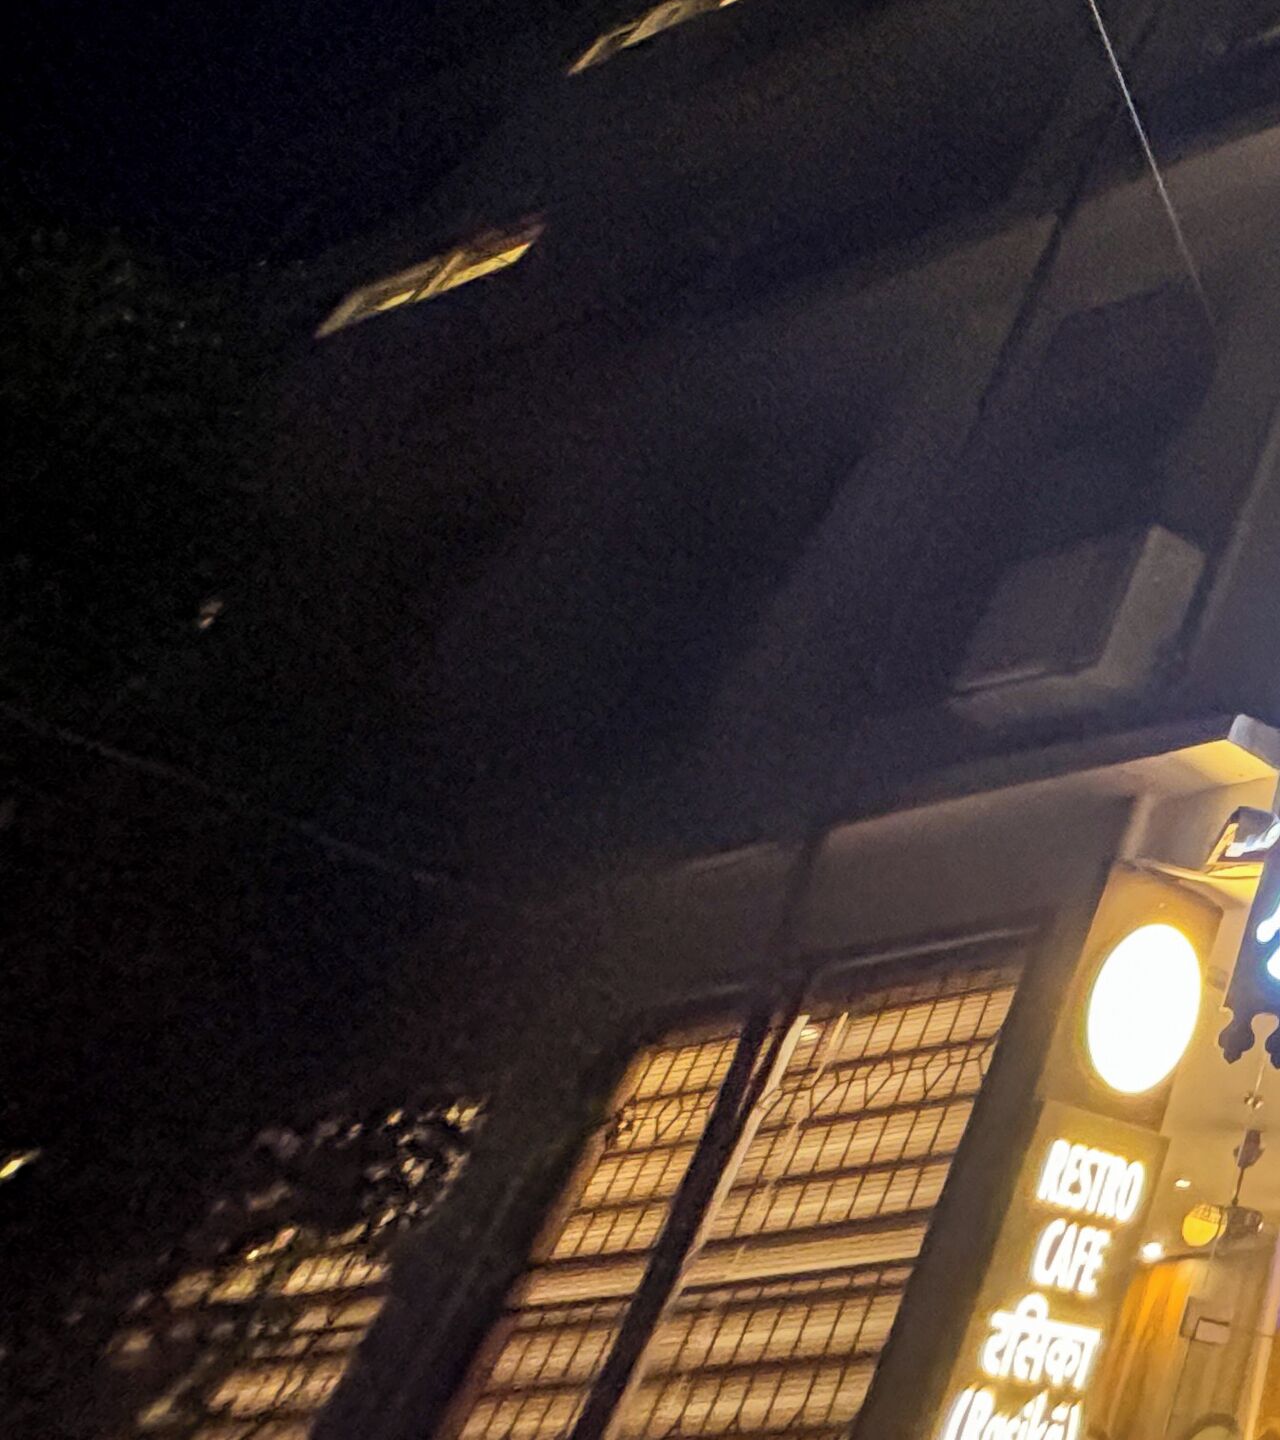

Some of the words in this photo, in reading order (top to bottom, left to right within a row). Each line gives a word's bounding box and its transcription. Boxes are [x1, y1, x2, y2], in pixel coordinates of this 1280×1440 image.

[1036, 1138, 1144, 1224] RESTRO
[1031, 1217, 1112, 1298] CAFE
[981, 1292, 1102, 1390] रसिका
